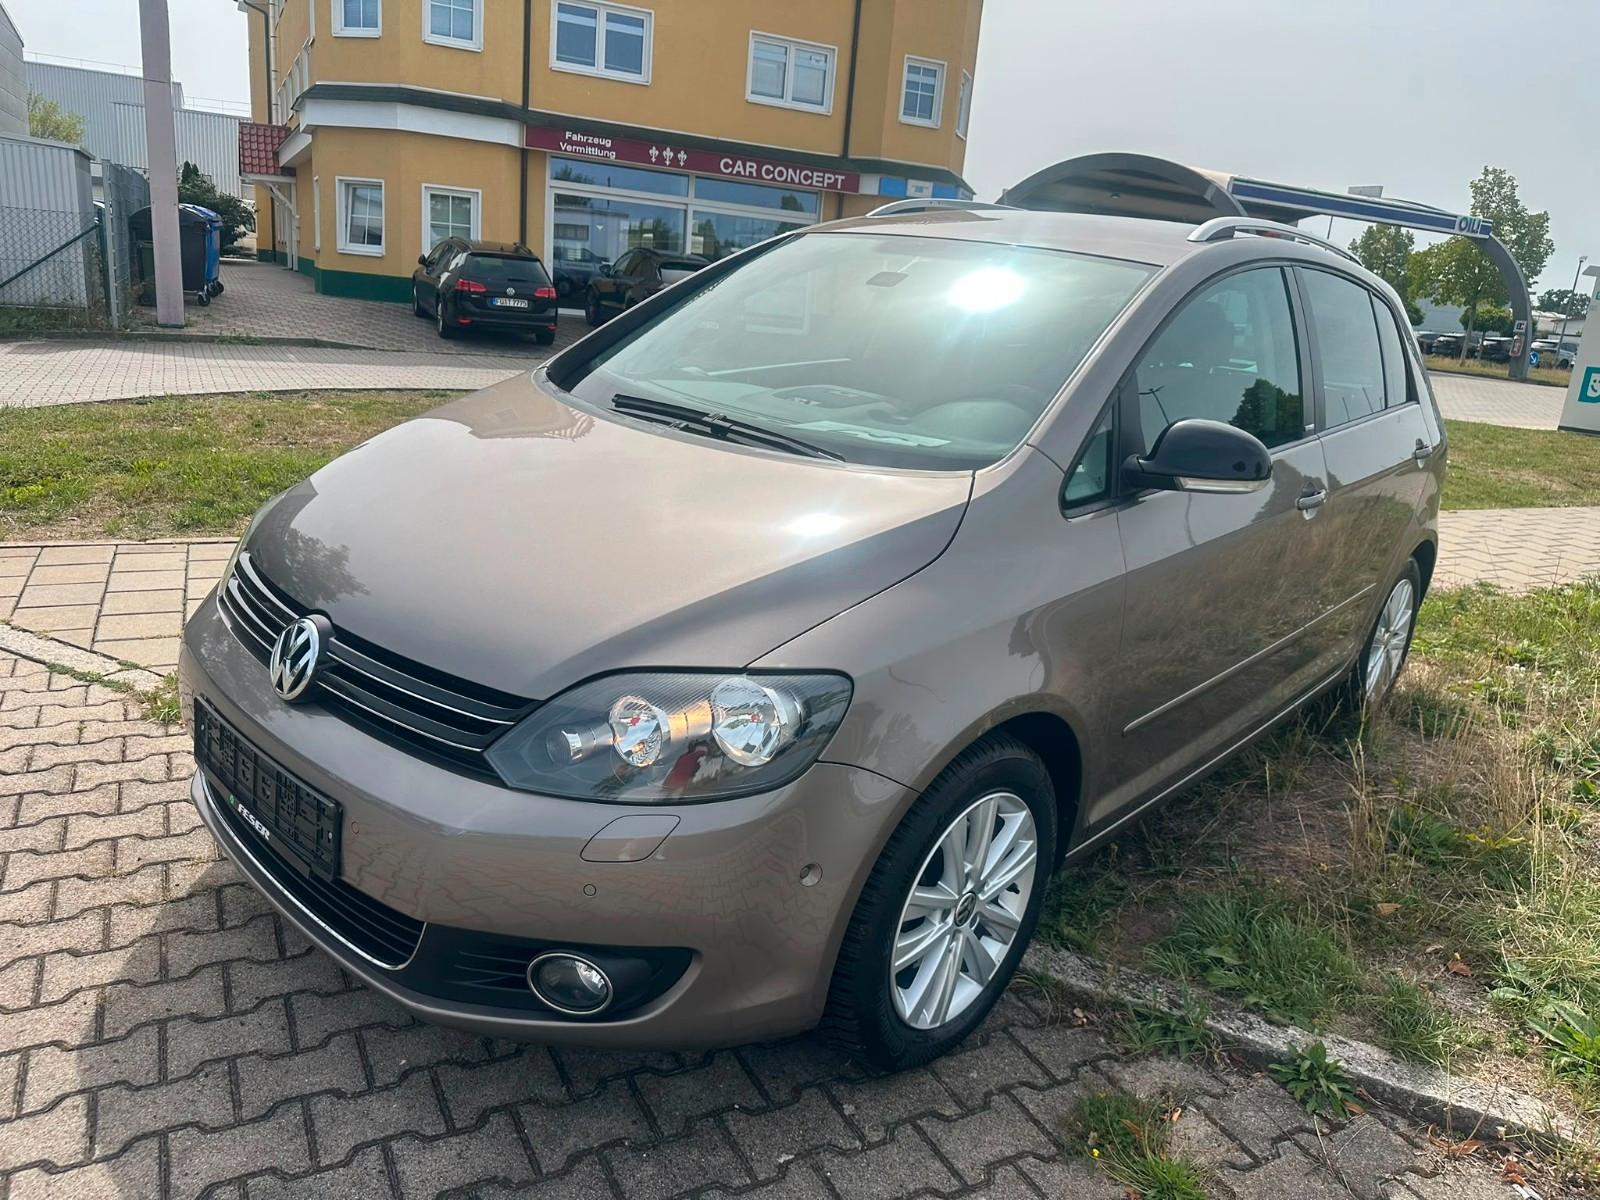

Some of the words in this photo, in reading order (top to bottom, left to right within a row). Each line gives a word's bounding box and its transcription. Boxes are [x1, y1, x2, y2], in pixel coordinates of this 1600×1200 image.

[559, 141, 616, 160] Vermittlung
[565, 131, 612, 148] Fahrzeug
[719, 157, 757, 177] CAR
[761, 164, 845, 190] CONCEPT
[237, 803, 271, 841] FESER
